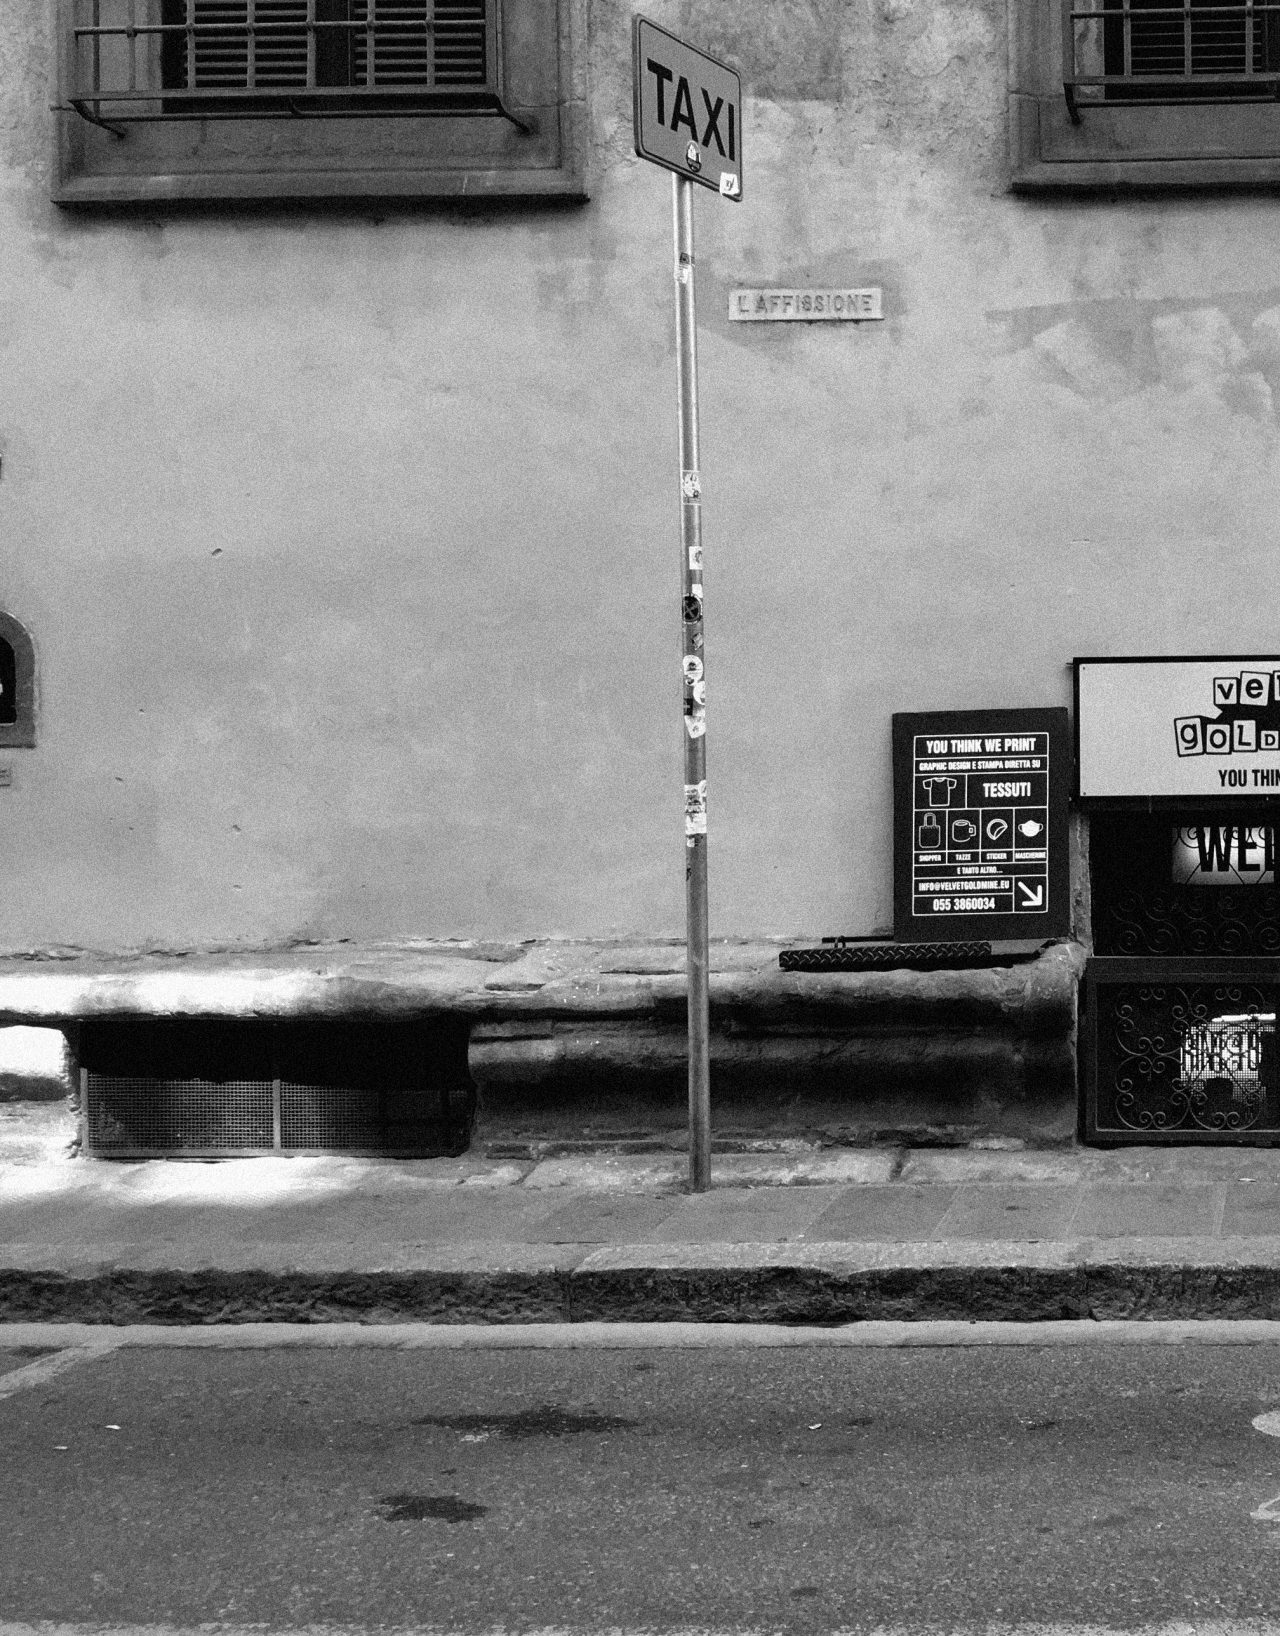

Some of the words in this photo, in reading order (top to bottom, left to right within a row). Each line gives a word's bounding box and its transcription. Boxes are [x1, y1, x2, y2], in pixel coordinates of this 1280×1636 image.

[646, 57, 736, 161] TAXI
[926, 740, 948, 754] YOU
[950, 739, 982, 753] THINK
[984, 738, 1002, 752] WE
[1004, 738, 1037, 751] PRINT
[919, 762, 947, 771] GRAPHIC
[948, 761, 971, 770] DESIGN
[972, 761, 977, 770] E
[977, 760, 1004, 769] STAMPA
[1005, 760, 1031, 769] DIRETTA
[1032, 759, 1041, 768] SU
[1218, 769, 1248, 788] YOU
[983, 782, 1031, 798] TESSUTI
[919, 880, 1010, 892] INFO@VELVETGOLDMINE.EU
[933, 898, 951, 911] 055
[953, 897, 996, 911] 3860034
